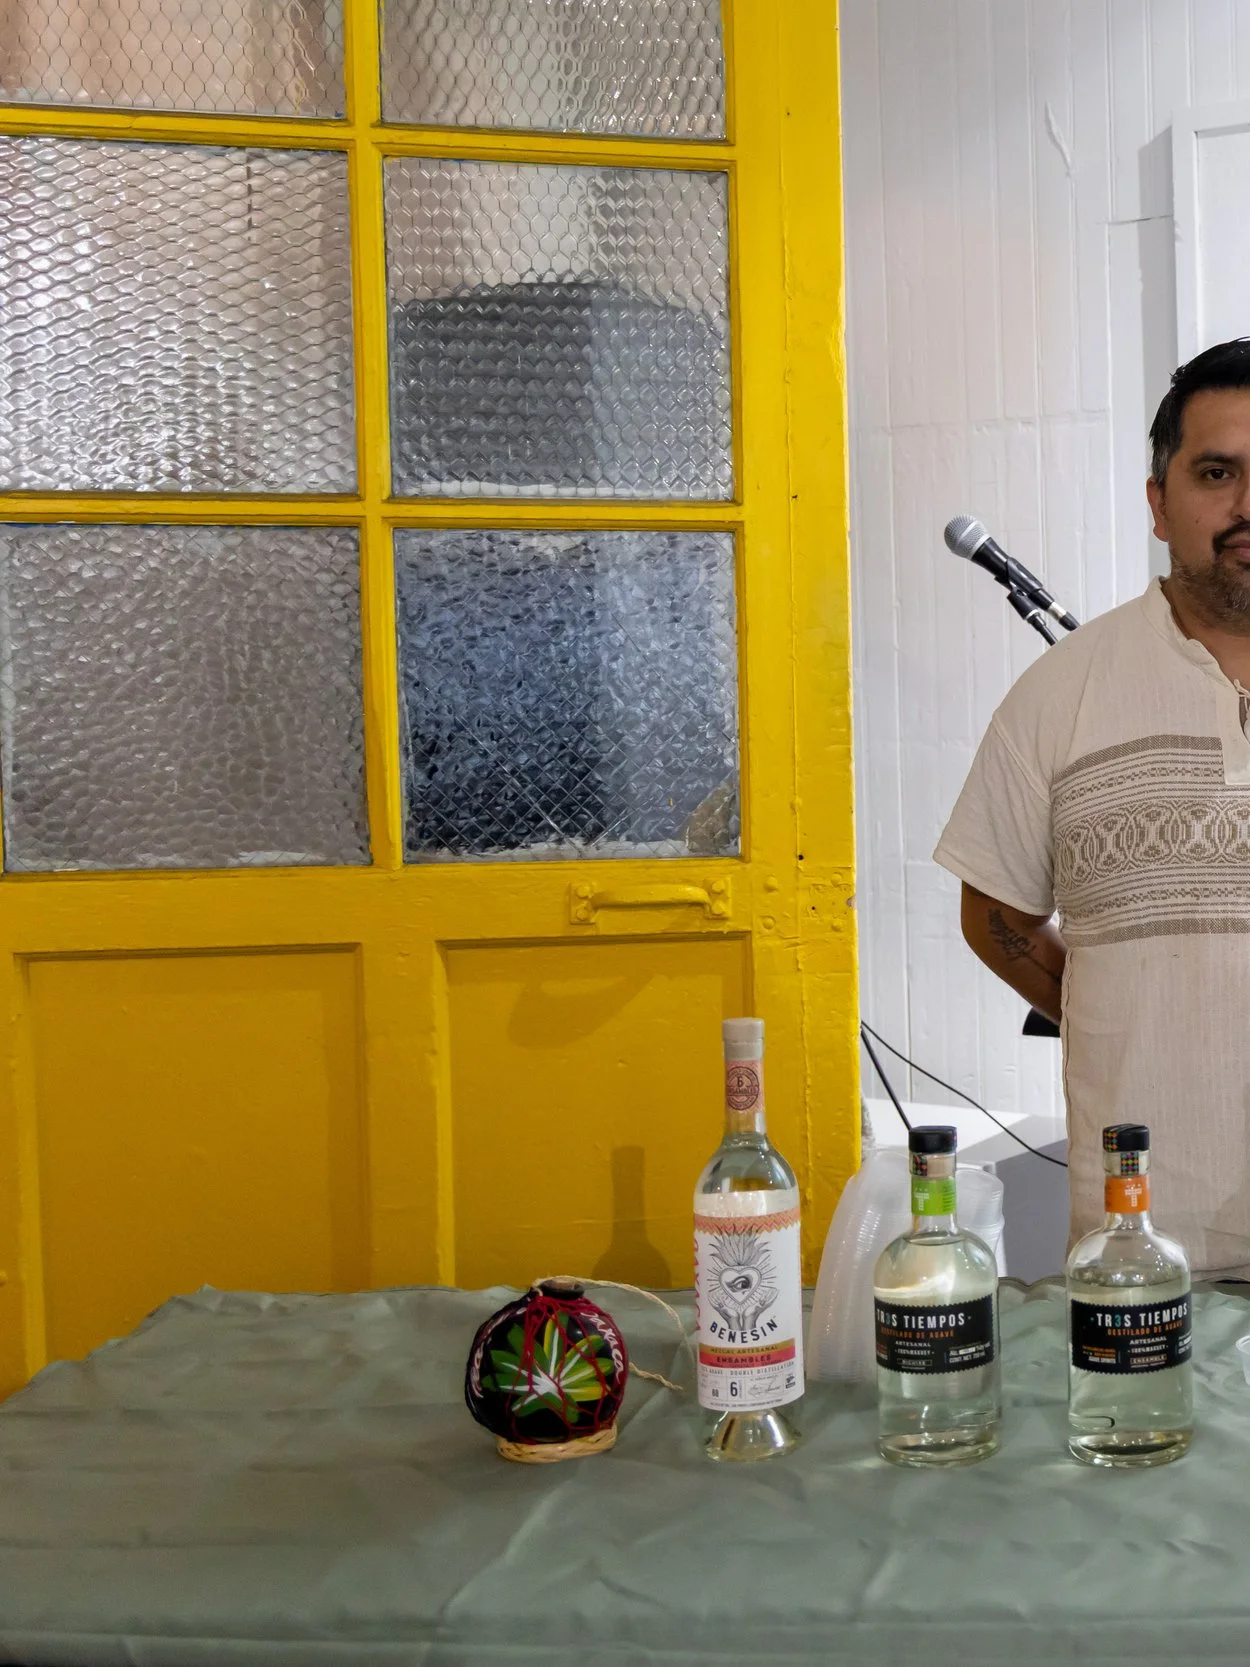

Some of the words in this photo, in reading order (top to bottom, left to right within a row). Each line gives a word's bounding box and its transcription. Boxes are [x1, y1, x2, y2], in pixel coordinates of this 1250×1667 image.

[903, 1312, 965, 1329] TIEMPOS
[1139, 1302, 1188, 1326] TIEMPOS
[709, 1319, 779, 1344] BENESIN
[1129, 1336, 1168, 1345] ARTESANAL
[716, 1354, 772, 1364] ENSAMBLES
[730, 1381, 738, 1397] 6
